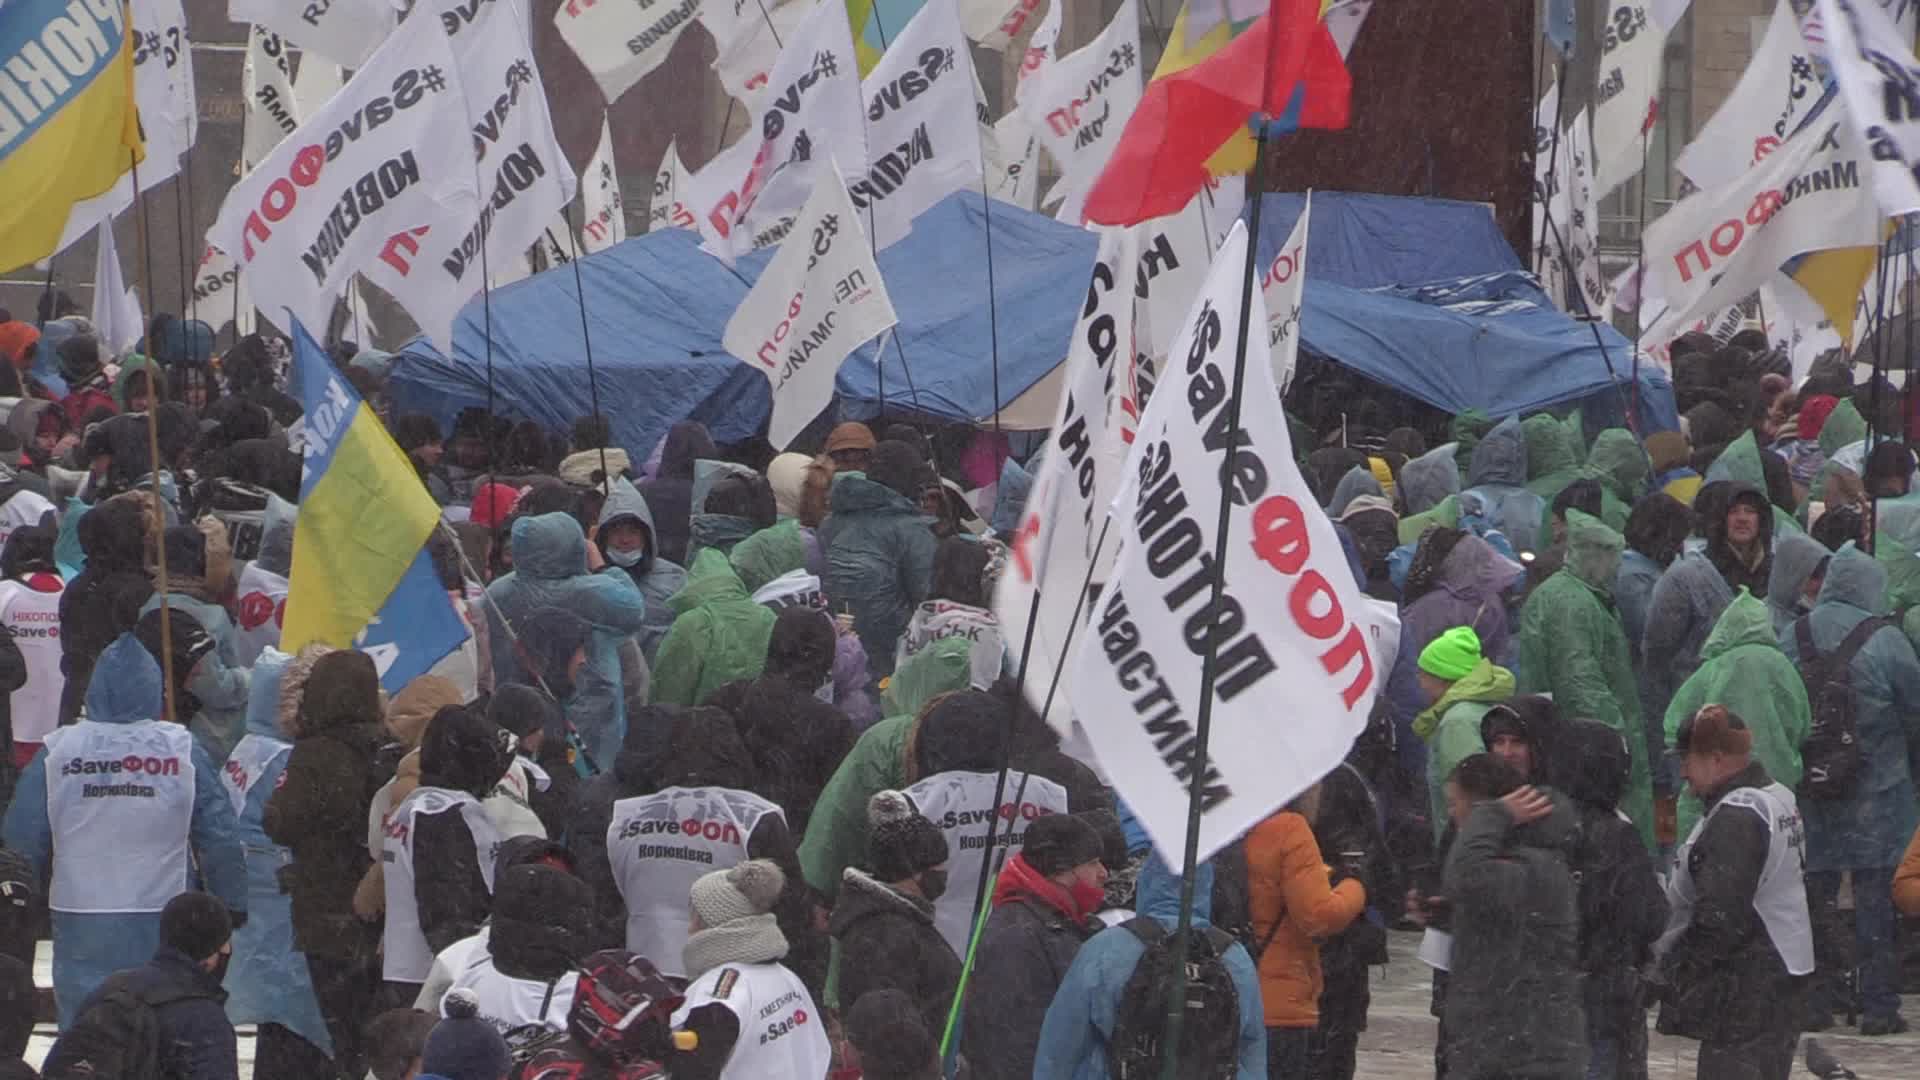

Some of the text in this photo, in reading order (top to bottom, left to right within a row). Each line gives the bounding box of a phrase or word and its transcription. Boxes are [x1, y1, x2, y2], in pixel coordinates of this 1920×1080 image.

[1135, 424, 1280, 703] НОТОП
[62, 755, 180, 777] #SaveФОП
[638, 844, 713, 865] Корюківка
